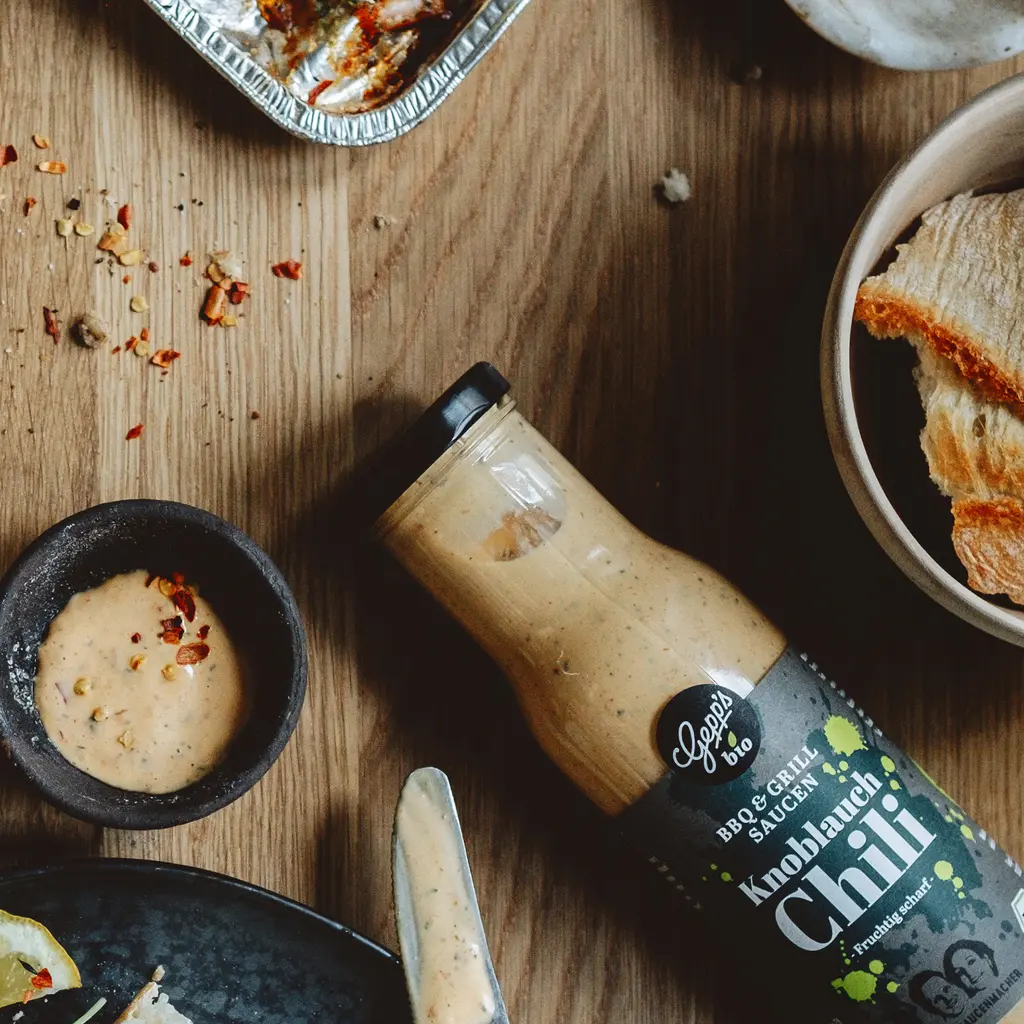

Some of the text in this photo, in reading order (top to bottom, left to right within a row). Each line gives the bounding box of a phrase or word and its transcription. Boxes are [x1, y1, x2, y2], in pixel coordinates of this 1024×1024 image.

[673, 690, 733, 774] Gepp's
[721, 737, 753, 766] bio
[716, 745, 819, 843] BBQ & GRILL
[748, 774, 819, 844] SAUCEN
[738, 770, 883, 907] Knoblauch
[775, 793, 937, 952] Chili
[852, 878, 932, 956] Fruchtig scharf
